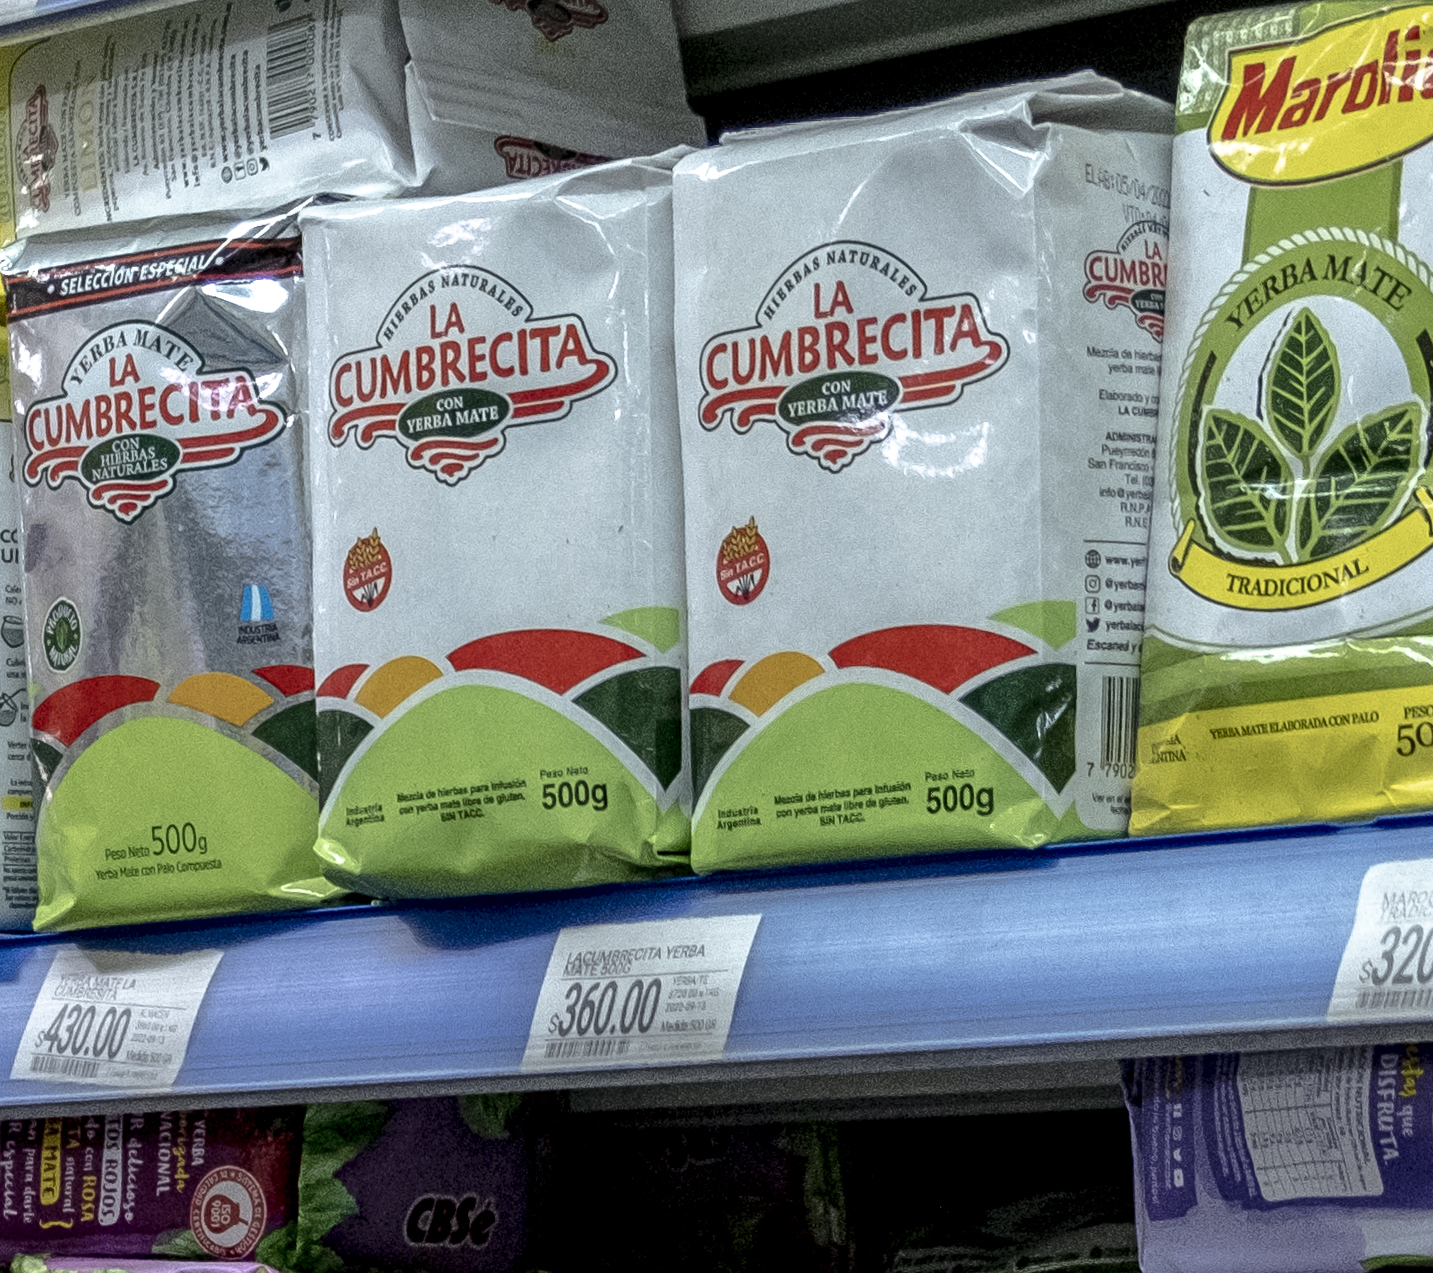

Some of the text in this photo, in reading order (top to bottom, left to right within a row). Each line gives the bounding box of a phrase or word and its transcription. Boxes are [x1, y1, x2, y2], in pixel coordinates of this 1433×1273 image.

[383, 274, 524, 342] HIERBAS NATURALES
[811, 279, 854, 320] LA
[1226, 253, 1413, 334] YERBA MATE
[428, 300, 465, 339] LA
[68, 330, 194, 386] YERBA MATE
[334, 323, 587, 389] CUMBRECITA
[706, 303, 981, 389] CUMBRECITA
[108, 355, 140, 384] LA
[27, 374, 259, 446] CUMBRECITA
[406, 406, 499, 432] YERBA MATE
[435, 395, 465, 411] CON
[1225, 559, 1368, 599] TRADICIONAL
[541, 777, 608, 811] 500g
[924, 782, 994, 815] 500g
[150, 820, 209, 858] 500g
[666, 945, 705, 959] YERBA
